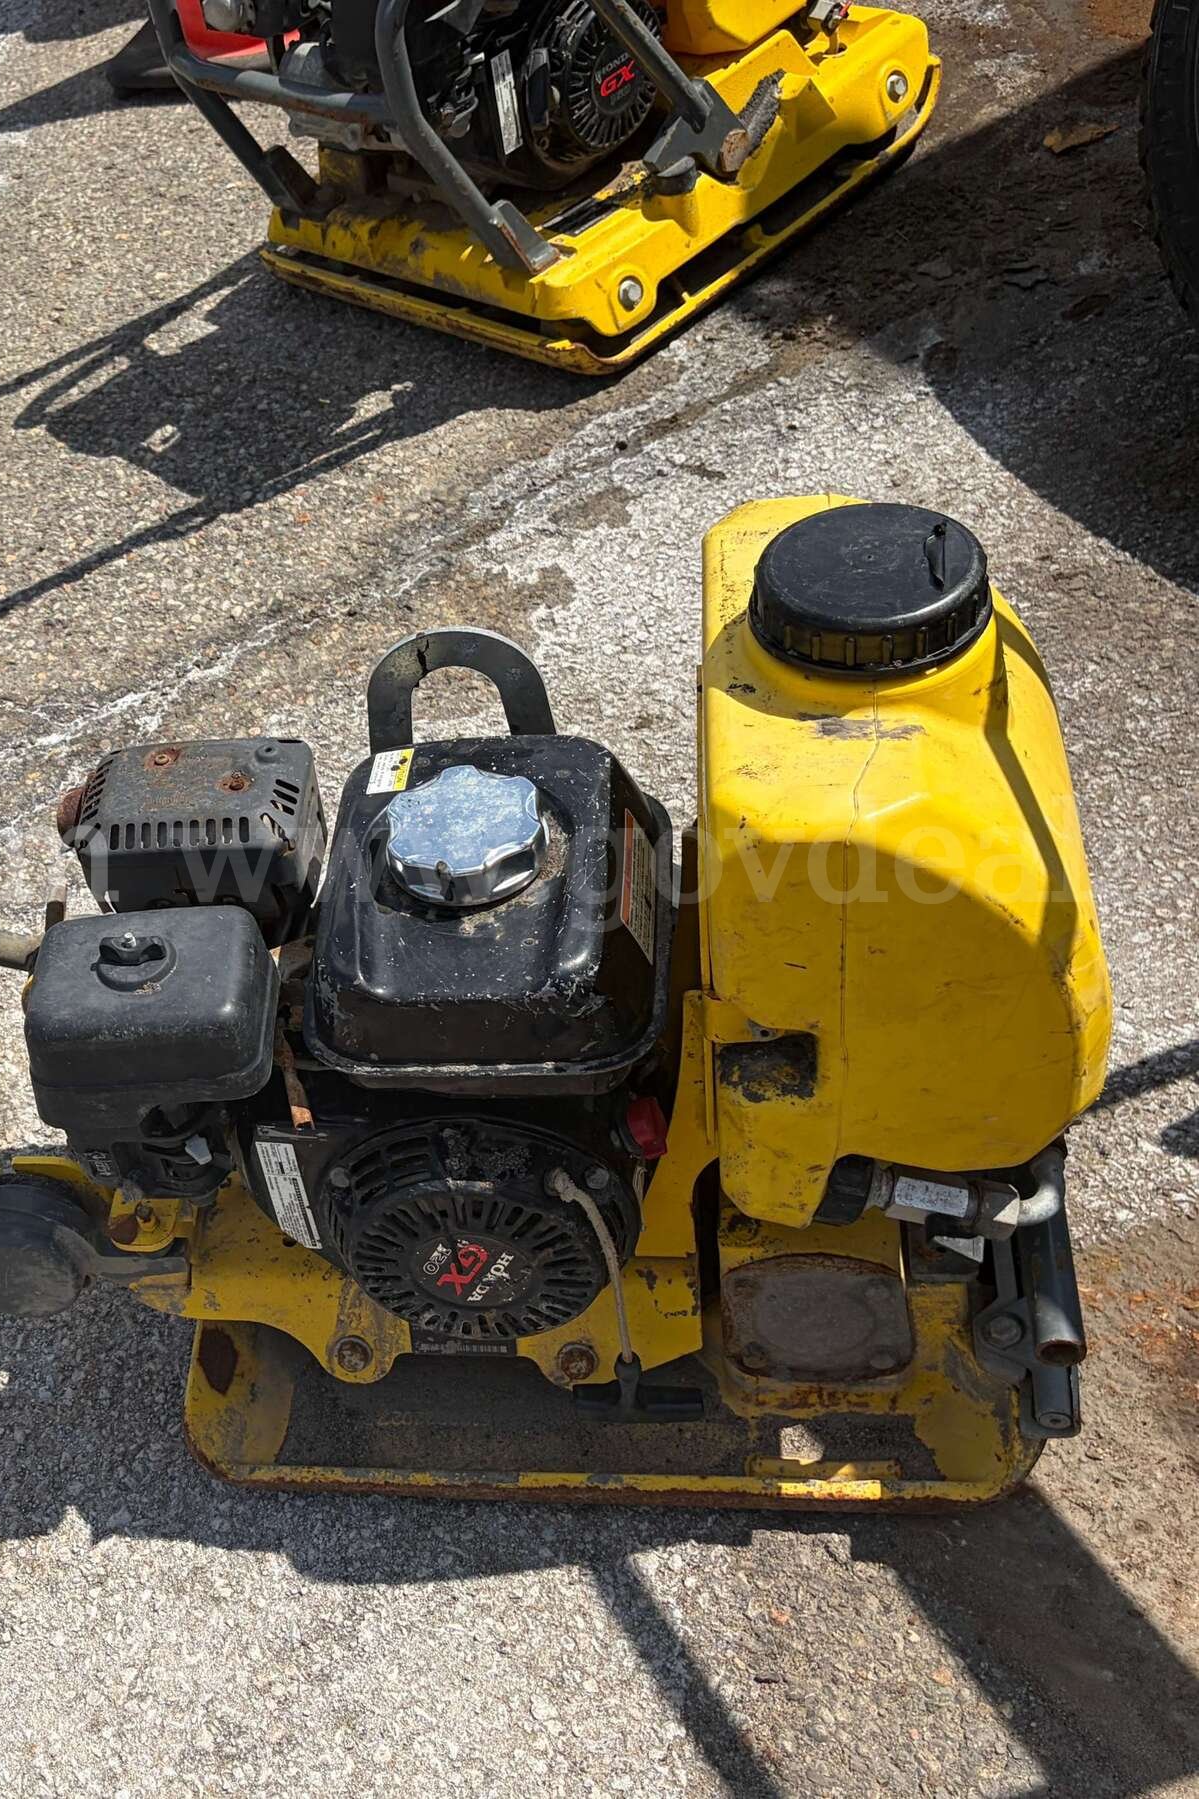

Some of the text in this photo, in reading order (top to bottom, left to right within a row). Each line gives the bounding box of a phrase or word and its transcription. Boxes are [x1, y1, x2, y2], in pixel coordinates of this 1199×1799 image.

[601, 60, 636, 96] GX
[423, 1243, 452, 1275] 120
[437, 1243, 489, 1296] GX
